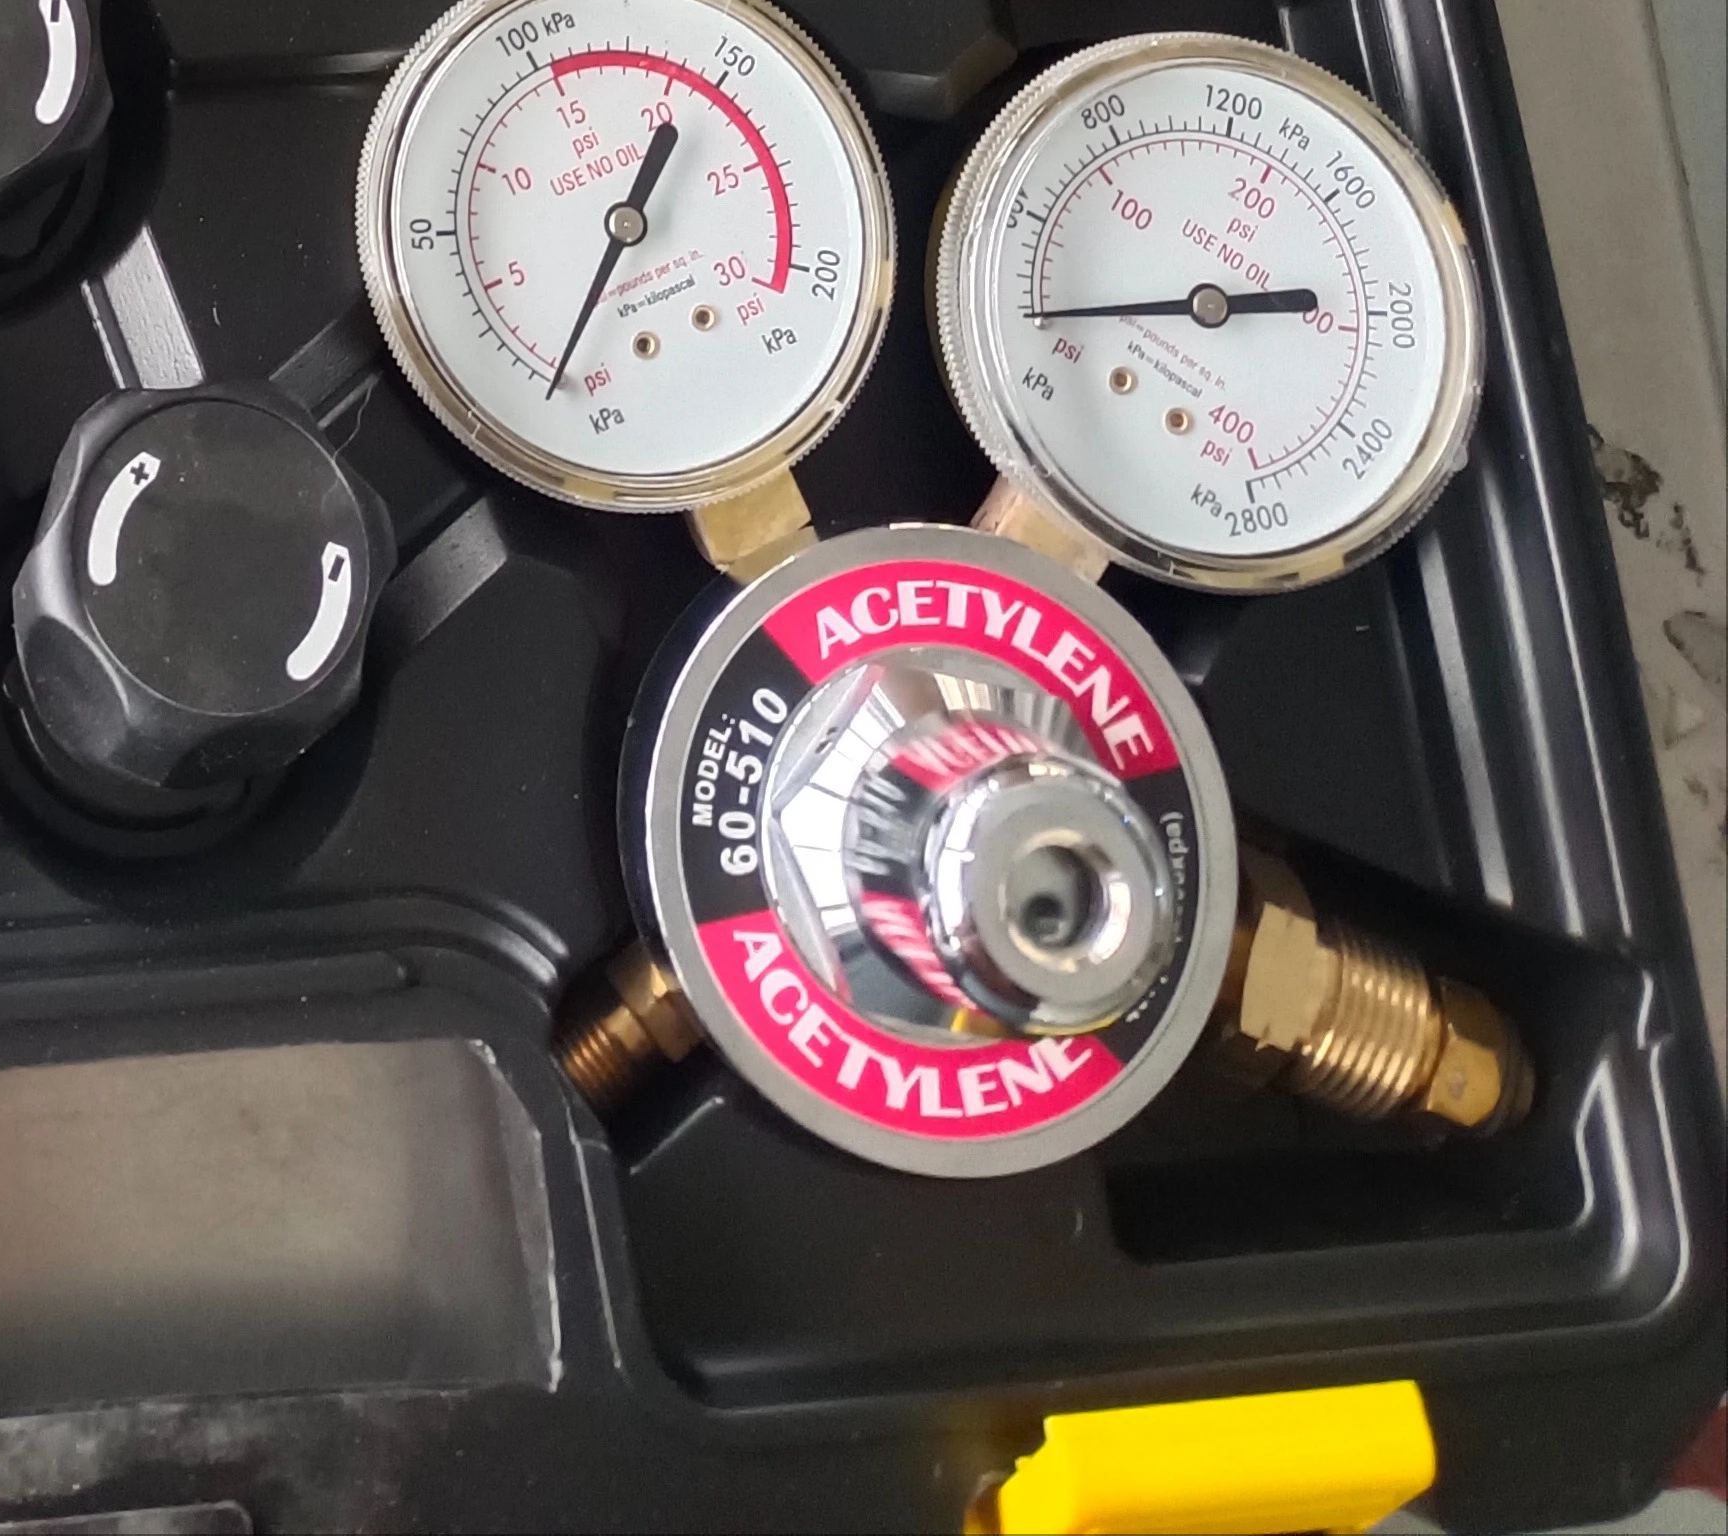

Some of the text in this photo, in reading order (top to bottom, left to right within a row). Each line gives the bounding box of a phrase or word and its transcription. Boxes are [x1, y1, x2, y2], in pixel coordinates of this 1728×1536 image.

[495, 12, 576, 57] 100 kPa
[713, 35, 756, 78] 150
[555, 99, 587, 129] 15
[640, 101, 673, 132] 20
[1080, 94, 1126, 130] 800
[1205, 84, 1263, 121] 1200
[572, 126, 600, 160] psi
[1278, 116, 1312, 151] kPa
[501, 166, 532, 196] 10
[549, 141, 647, 197] USE NO OIL
[706, 163, 740, 196] 25
[1324, 150, 1377, 210] 1600
[1110, 188, 1154, 231] 100
[1227, 177, 1276, 220] 200
[409, 217, 435, 250] 50
[1226, 217, 1259, 244] psi
[507, 260, 526, 287] 5
[654, 262, 671, 279] per
[712, 254, 746, 287] 30
[1181, 218, 1272, 293] USE NO OIL
[811, 249, 842, 302] 200
[736, 292, 765, 326] psi
[1302, 303, 1335, 335] 00
[1387, 281, 1416, 349] 2000
[761, 326, 798, 355] kPa
[1051, 336, 1085, 364] psi
[584, 362, 612, 397] psi
[1021, 366, 1055, 402] kPa
[589, 407, 625, 435] kPa
[1208, 404, 1255, 444] 400
[1200, 438, 1234, 467] psi
[1341, 417, 1393, 481] 2400
[1190, 482, 1223, 519] kPa
[1224, 501, 1289, 537] 2800
[813, 579, 1156, 771] ACETYLENE
[691, 712, 737, 828] MODEL:
[718, 687, 788, 877] 60-510
[731, 925, 1094, 1119] ACETYLENE
